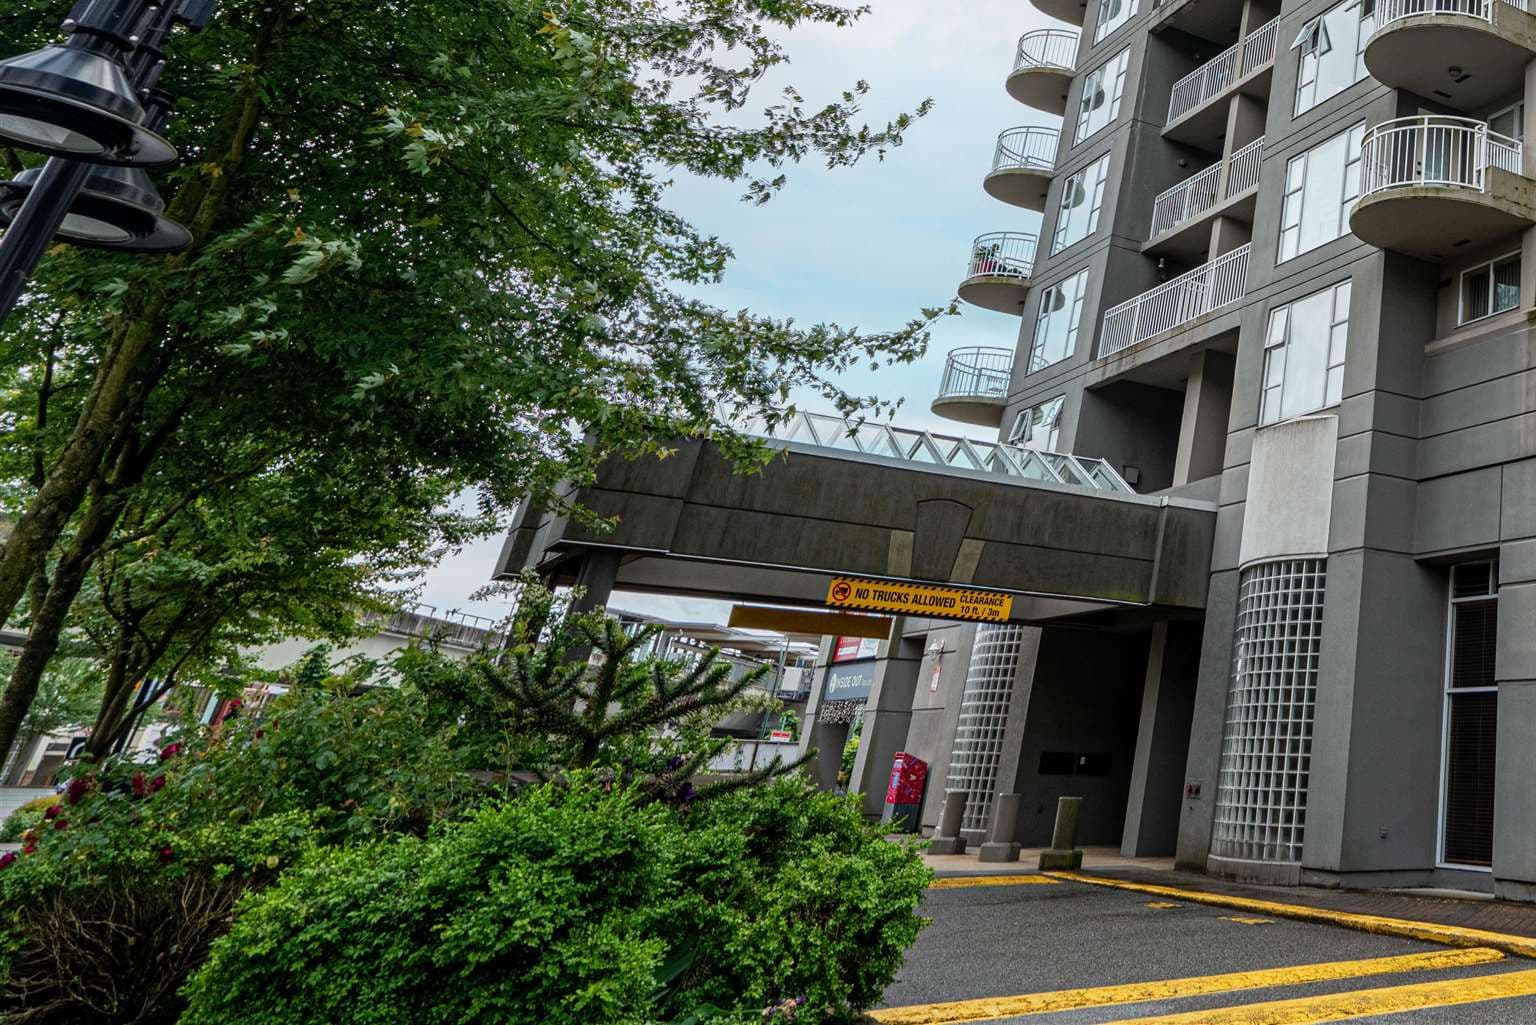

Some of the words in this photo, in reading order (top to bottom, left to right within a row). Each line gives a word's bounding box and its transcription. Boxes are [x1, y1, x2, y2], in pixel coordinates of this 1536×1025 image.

[855, 588, 870, 600] NO
[872, 589, 910, 604] TRUCKS
[911, 593, 956, 608] ALLOWED
[960, 594, 1004, 607] CLEARANCE
[961, 606, 970, 614] 10
[988, 607, 1000, 616] 3m
